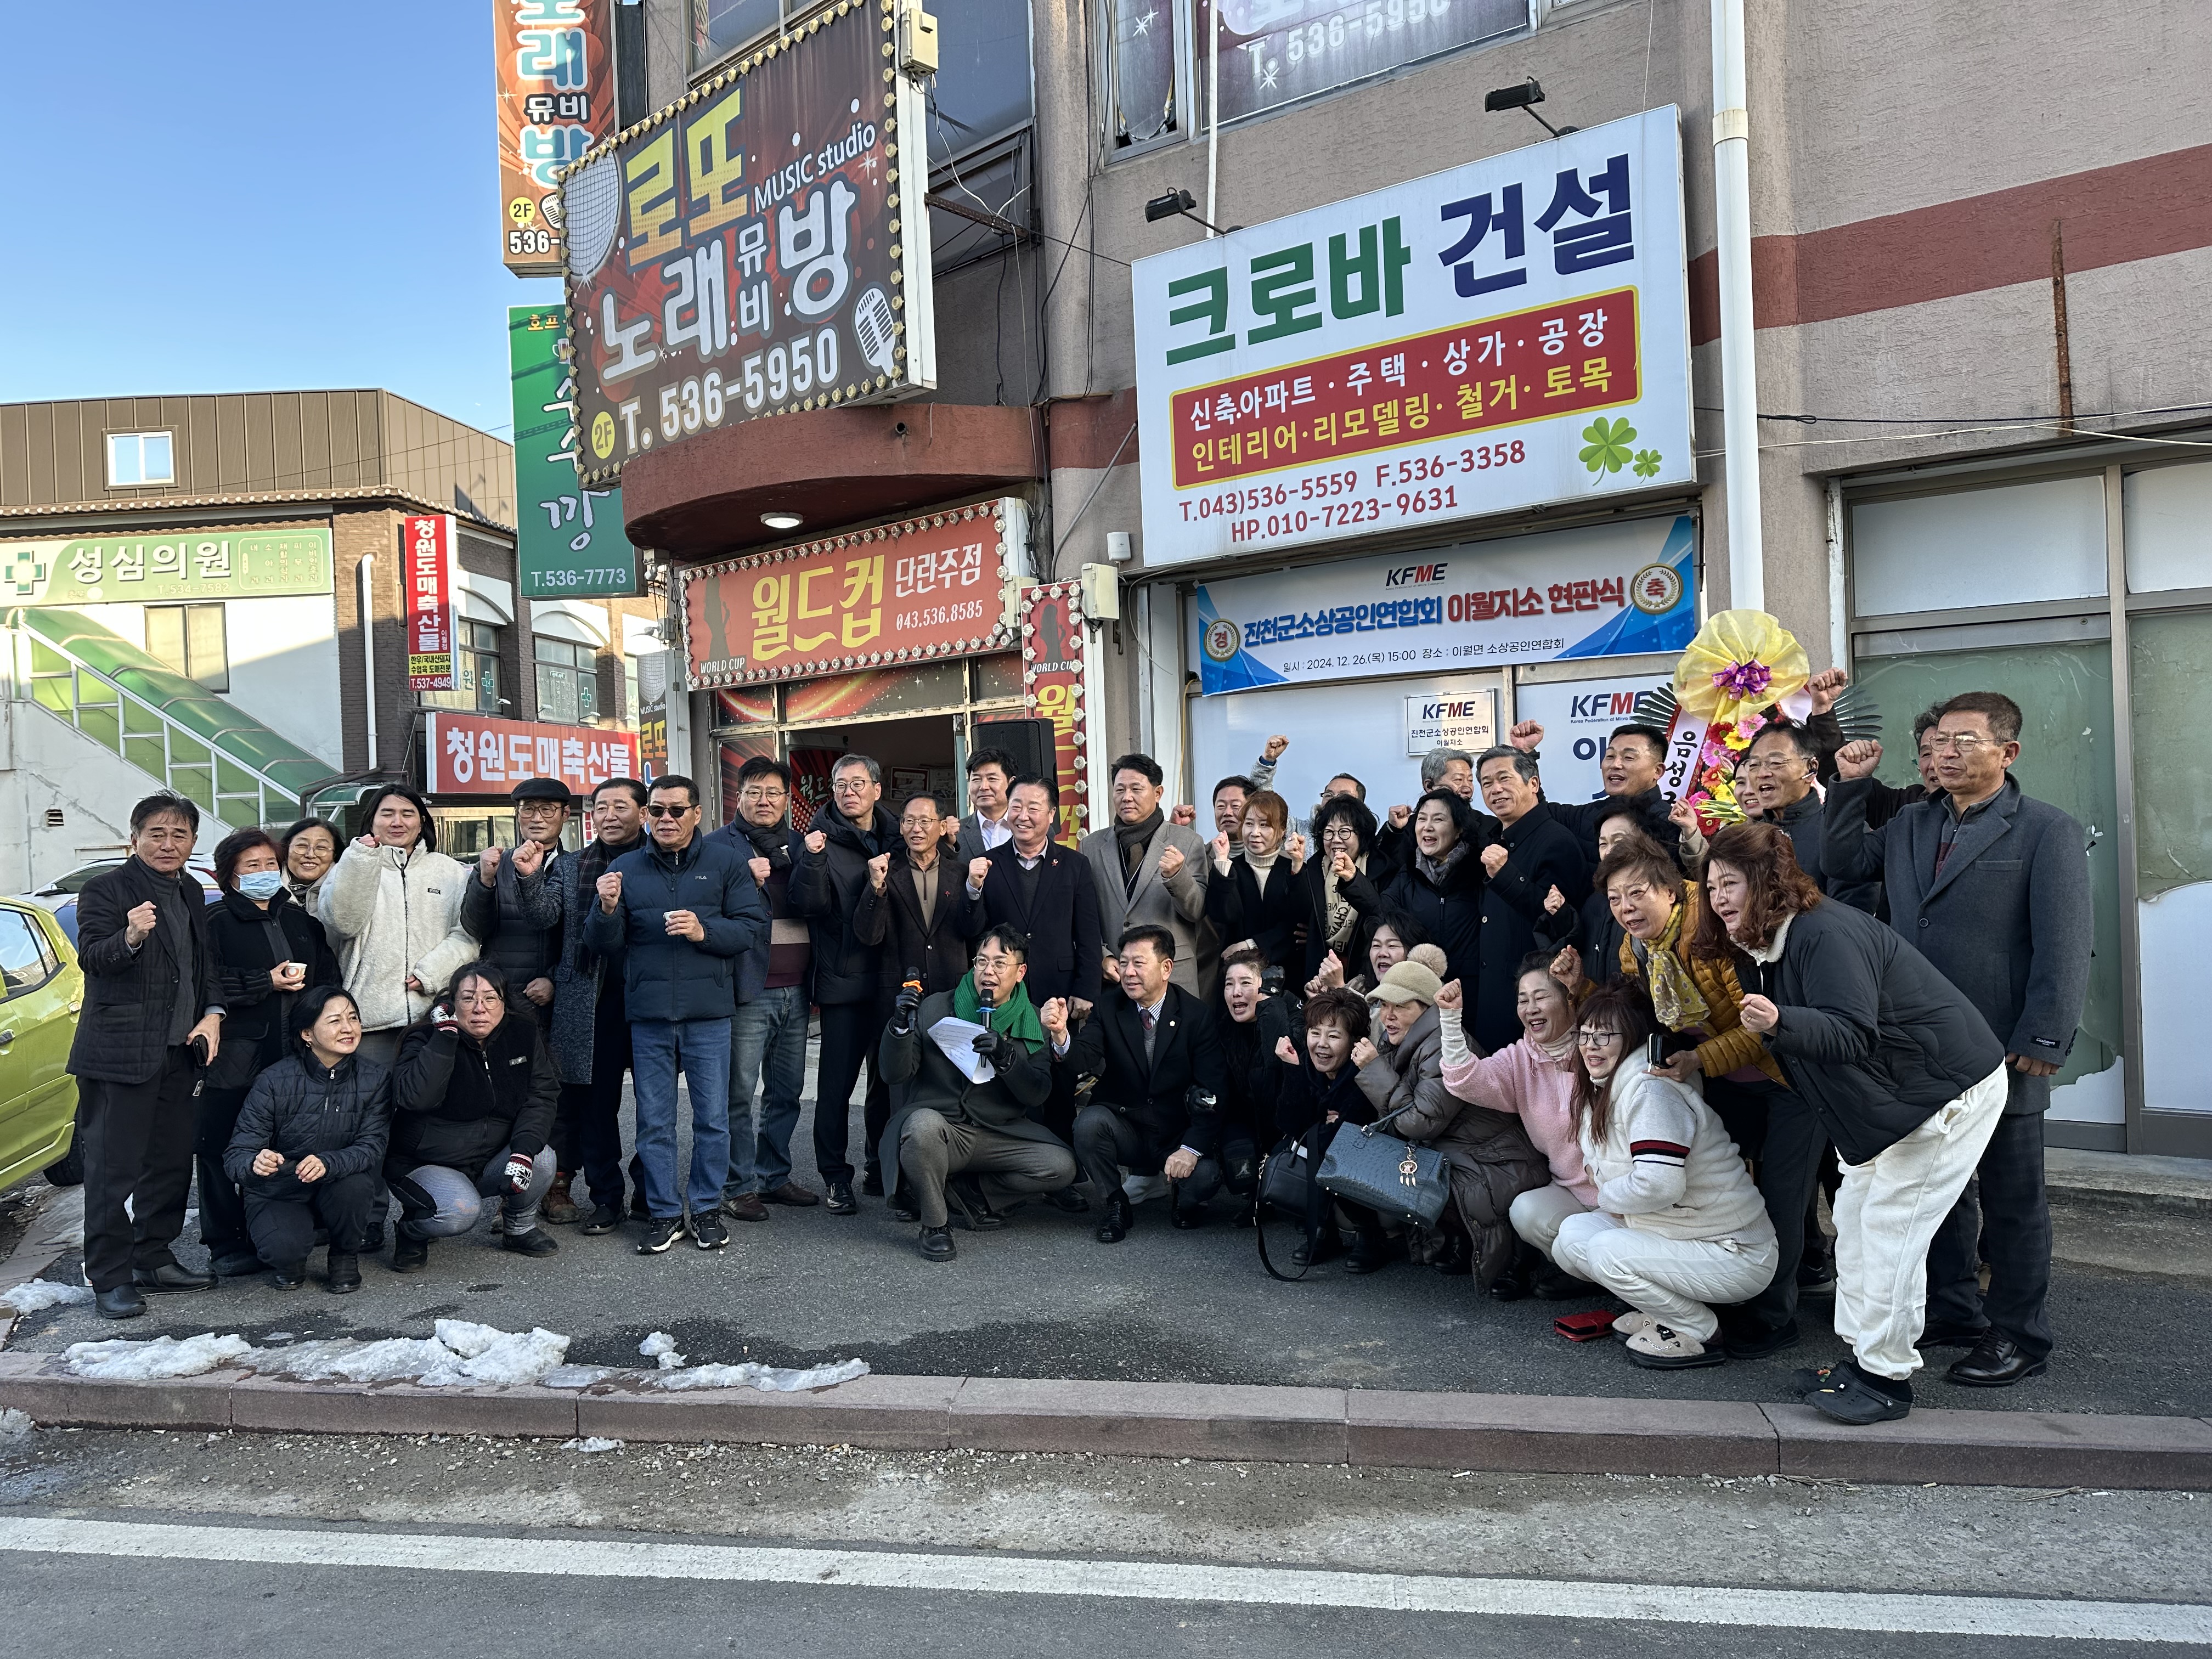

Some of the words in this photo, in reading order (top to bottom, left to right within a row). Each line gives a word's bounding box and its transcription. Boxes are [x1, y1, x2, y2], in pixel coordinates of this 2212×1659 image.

[527, 95, 587, 122] 뮤비
[625, 88, 747, 267] 로또
[754, 153, 814, 213] MUSIC
[817, 122, 876, 176] studio
[514, 204, 532, 217] 2F
[1166, 216, 1411, 366] 크로바
[1438, 153, 1635, 297] 건설
[1538, 308, 1608, 356] 공장
[661, 328, 838, 437] 536-5950
[1543, 356, 1613, 398] 토목
[595, 421, 612, 451] 2F
[1179, 470, 1358, 522] T.043)536-5559
[1375, 439, 1526, 487] F.536-3358
[1231, 484, 1458, 543] HP.010-7223-9631
[67, 540, 232, 584] 성심의원
[895, 543, 983, 597] 단란주점
[1386, 562, 1448, 586] KFME
[157, 582, 230, 596] T.534-7582
[414, 519, 441, 652] 청원도매축산물
[531, 568, 627, 588] T.536-7773
[1645, 578, 1667, 598] 축
[752, 554, 885, 661] 월드컵
[896, 599, 983, 631] 043.536.8585
[1244, 596, 1442, 648] 진천군소상공인연합회
[1448, 586, 1544, 622] 이월지소
[1548, 576, 1624, 614] 현판식
[1214, 631, 1228, 648] 경
[1387, 650, 1416, 662] 15:00
[1452, 644, 1484, 657] 이월면
[1487, 637, 1565, 654] 소상공인연합회
[700, 659, 727, 675] WORLD
[729, 657, 745, 671] CUP
[1060, 660, 1074, 670] CU
[410, 676, 452, 689] T.537-4949
[640, 704, 653, 715] MUSIC
[653, 702, 666, 712] studio
[1423, 701, 1476, 720] KFME
[641, 720, 667, 759] 로또
[1411, 725, 1489, 738] 진천군소상공인연합회
[1436, 738, 1463, 747] 이월지소
[447, 727, 630, 785] 청원도매축산물
